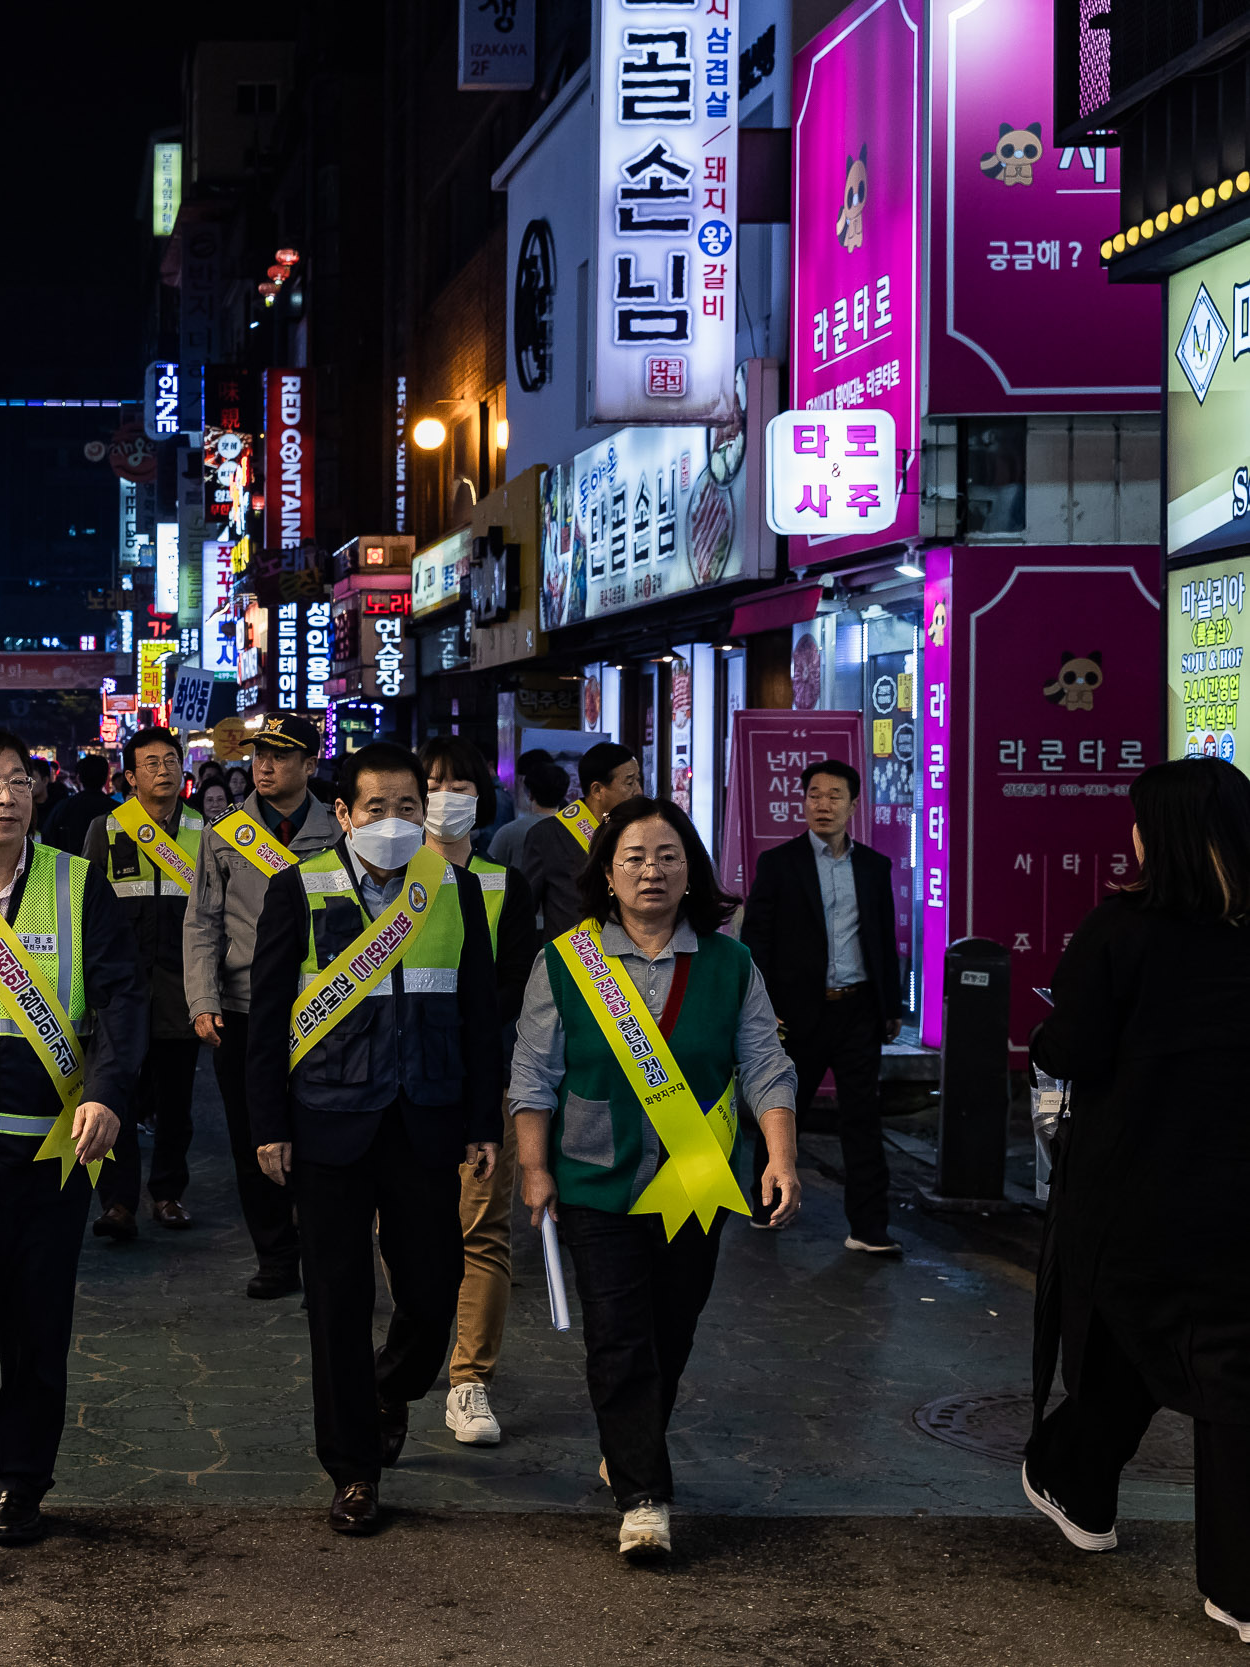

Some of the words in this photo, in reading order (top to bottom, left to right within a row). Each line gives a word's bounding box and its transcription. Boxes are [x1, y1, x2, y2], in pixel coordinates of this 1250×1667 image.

[470, 44, 528, 57] IZAKAYA
[470, 61, 490, 76] 2F
[617, 0, 691, 341] 골손님
[987, 240, 1060, 270] 궁금해
[813, 275, 892, 360] 라쿤타로
[281, 375, 301, 424] RED
[793, 425, 879, 457] 타로
[831, 463, 841, 478] &
[591, 468, 675, 577] 단골손님
[795, 485, 880, 517] 사주
[1181, 572, 1246, 621] 마실리아
[144, 655, 160, 703] 노래방
[278, 602, 298, 709] 레드컨테이너
[306, 602, 331, 708] 성인용품
[374, 617, 405, 697] 연습장
[1182, 650, 1206, 674] SOJU
[1208, 651, 1217, 671] &
[1219, 647, 1243, 669] HOF
[1183, 674, 1240, 703] 24시간영업
[1186, 703, 1238, 732] 단체석완비
[999, 740, 1145, 770] 라쿤타로
[1221, 741, 1233, 759] 3F
[928, 682, 945, 908] 라쿤타로
[350, 911, 413, 982] 범죄없는
[295, 972, 356, 1038] 건대맛의
[568, 930, 611, 980] 안전하고
[594, 976, 631, 1018] 건전한
[616, 1014, 654, 1060] 청년의
[637, 1056, 669, 1088] 거리
[16, 986, 63, 1044] 청년의
[49, 1036, 80, 1078] 거리
[644, 1083, 686, 1105] 화양지구대
